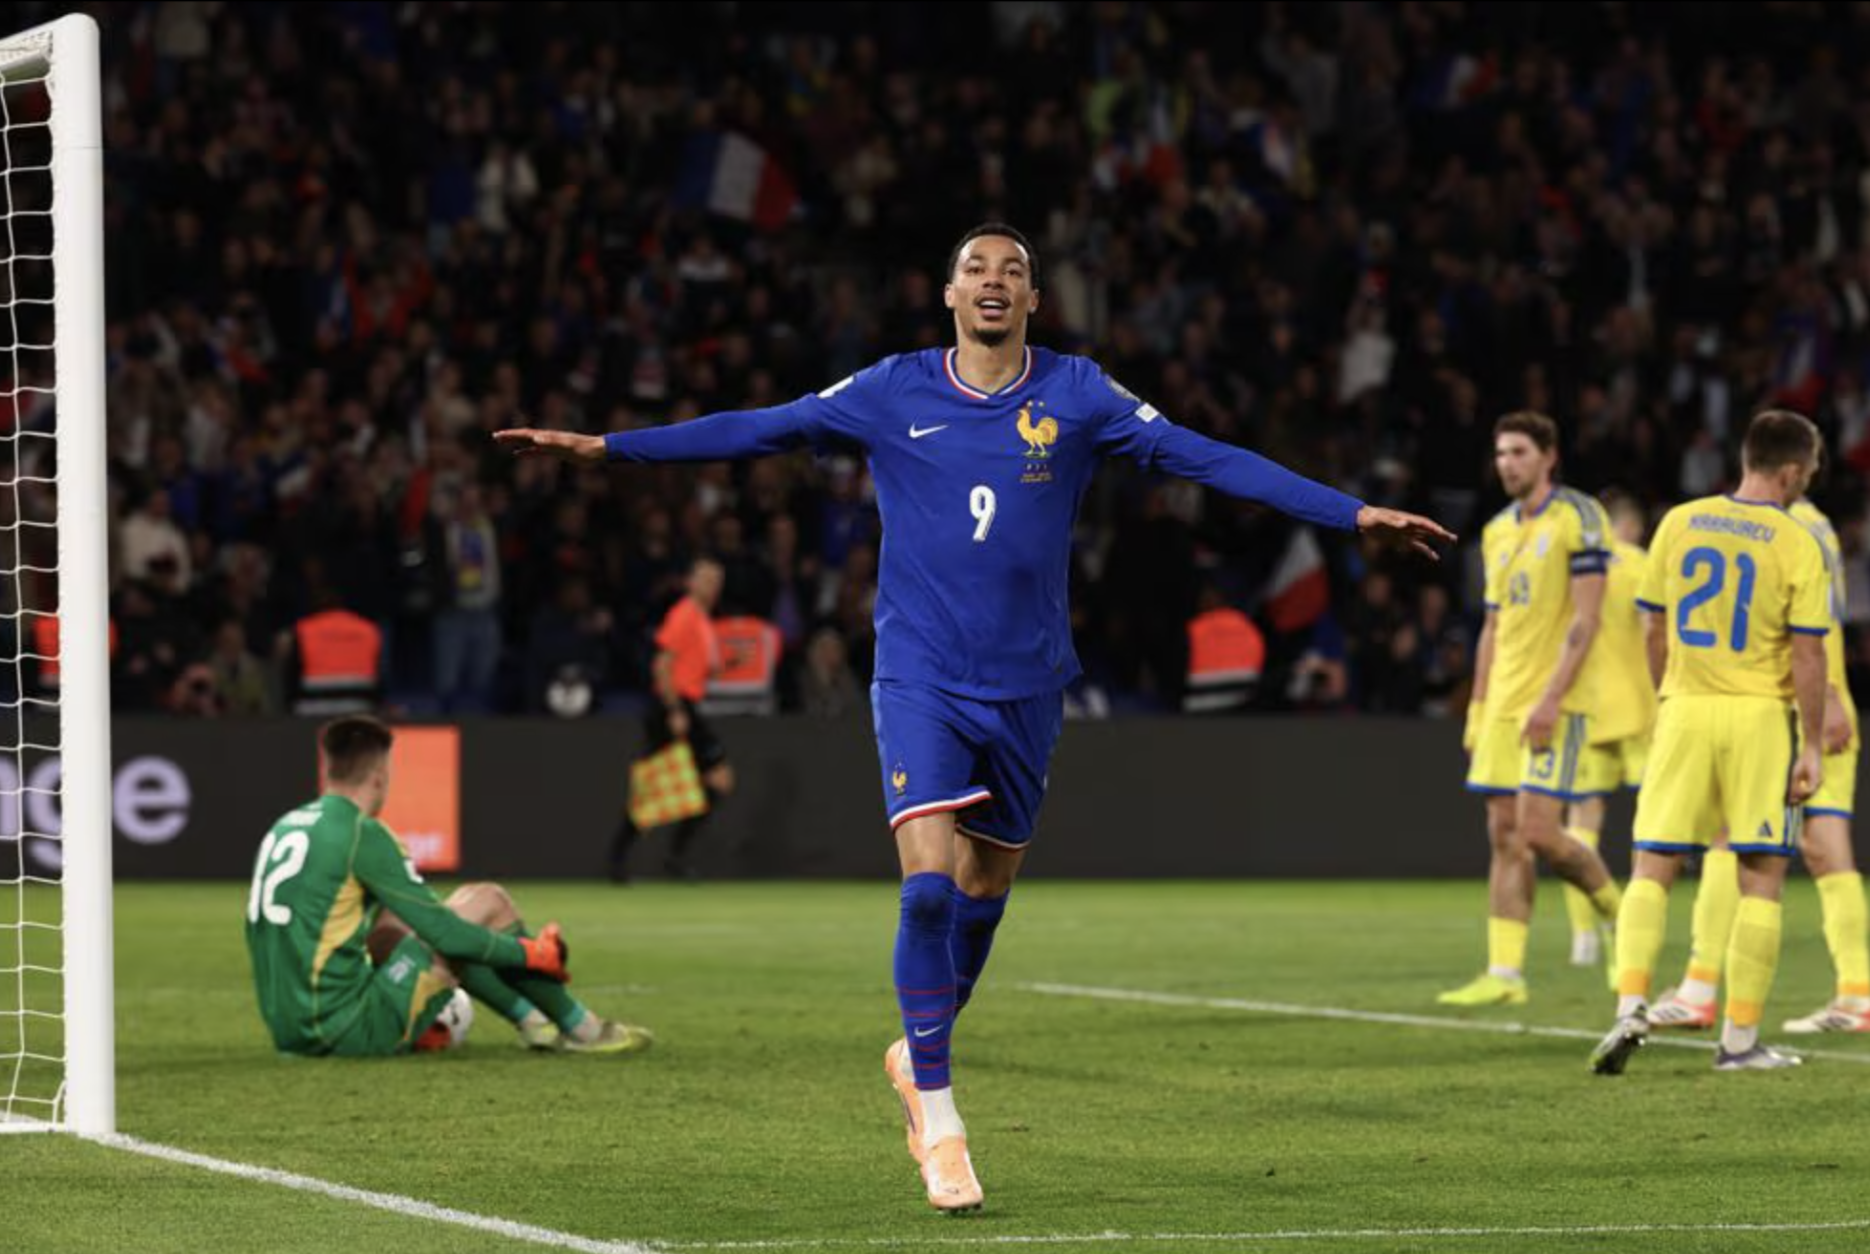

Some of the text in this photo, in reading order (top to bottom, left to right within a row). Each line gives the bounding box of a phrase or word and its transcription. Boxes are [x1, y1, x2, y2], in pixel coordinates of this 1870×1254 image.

[969, 485, 996, 541] 9
[1677, 546, 1757, 653] 21
[247, 830, 310, 926] 12
